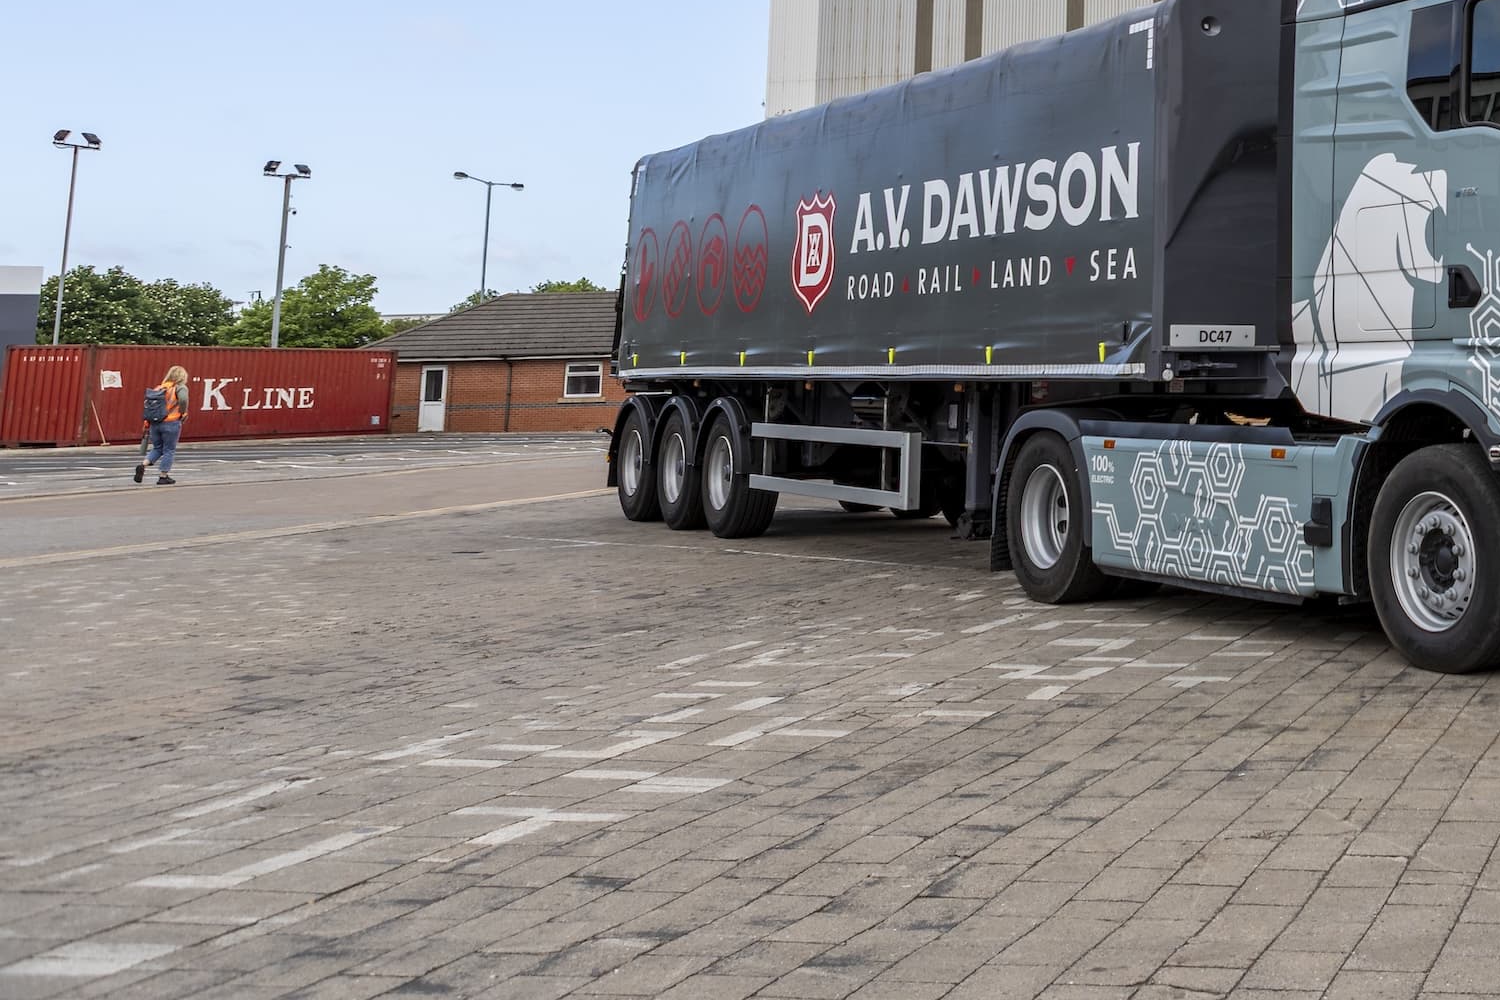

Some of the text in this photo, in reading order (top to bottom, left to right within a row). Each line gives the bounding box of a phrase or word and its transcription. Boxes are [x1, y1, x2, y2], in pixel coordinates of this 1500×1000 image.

[850, 142, 1140, 254] A.V. DAWSON
[847, 247, 1138, 300] ROAD RAIL LAND SEA
[1200, 330, 1232, 343] DC47
[241, 387, 315, 409] LINE
[1091, 455, 1115, 473] 100%
[1091, 474, 1114, 484] ELECTRIC
